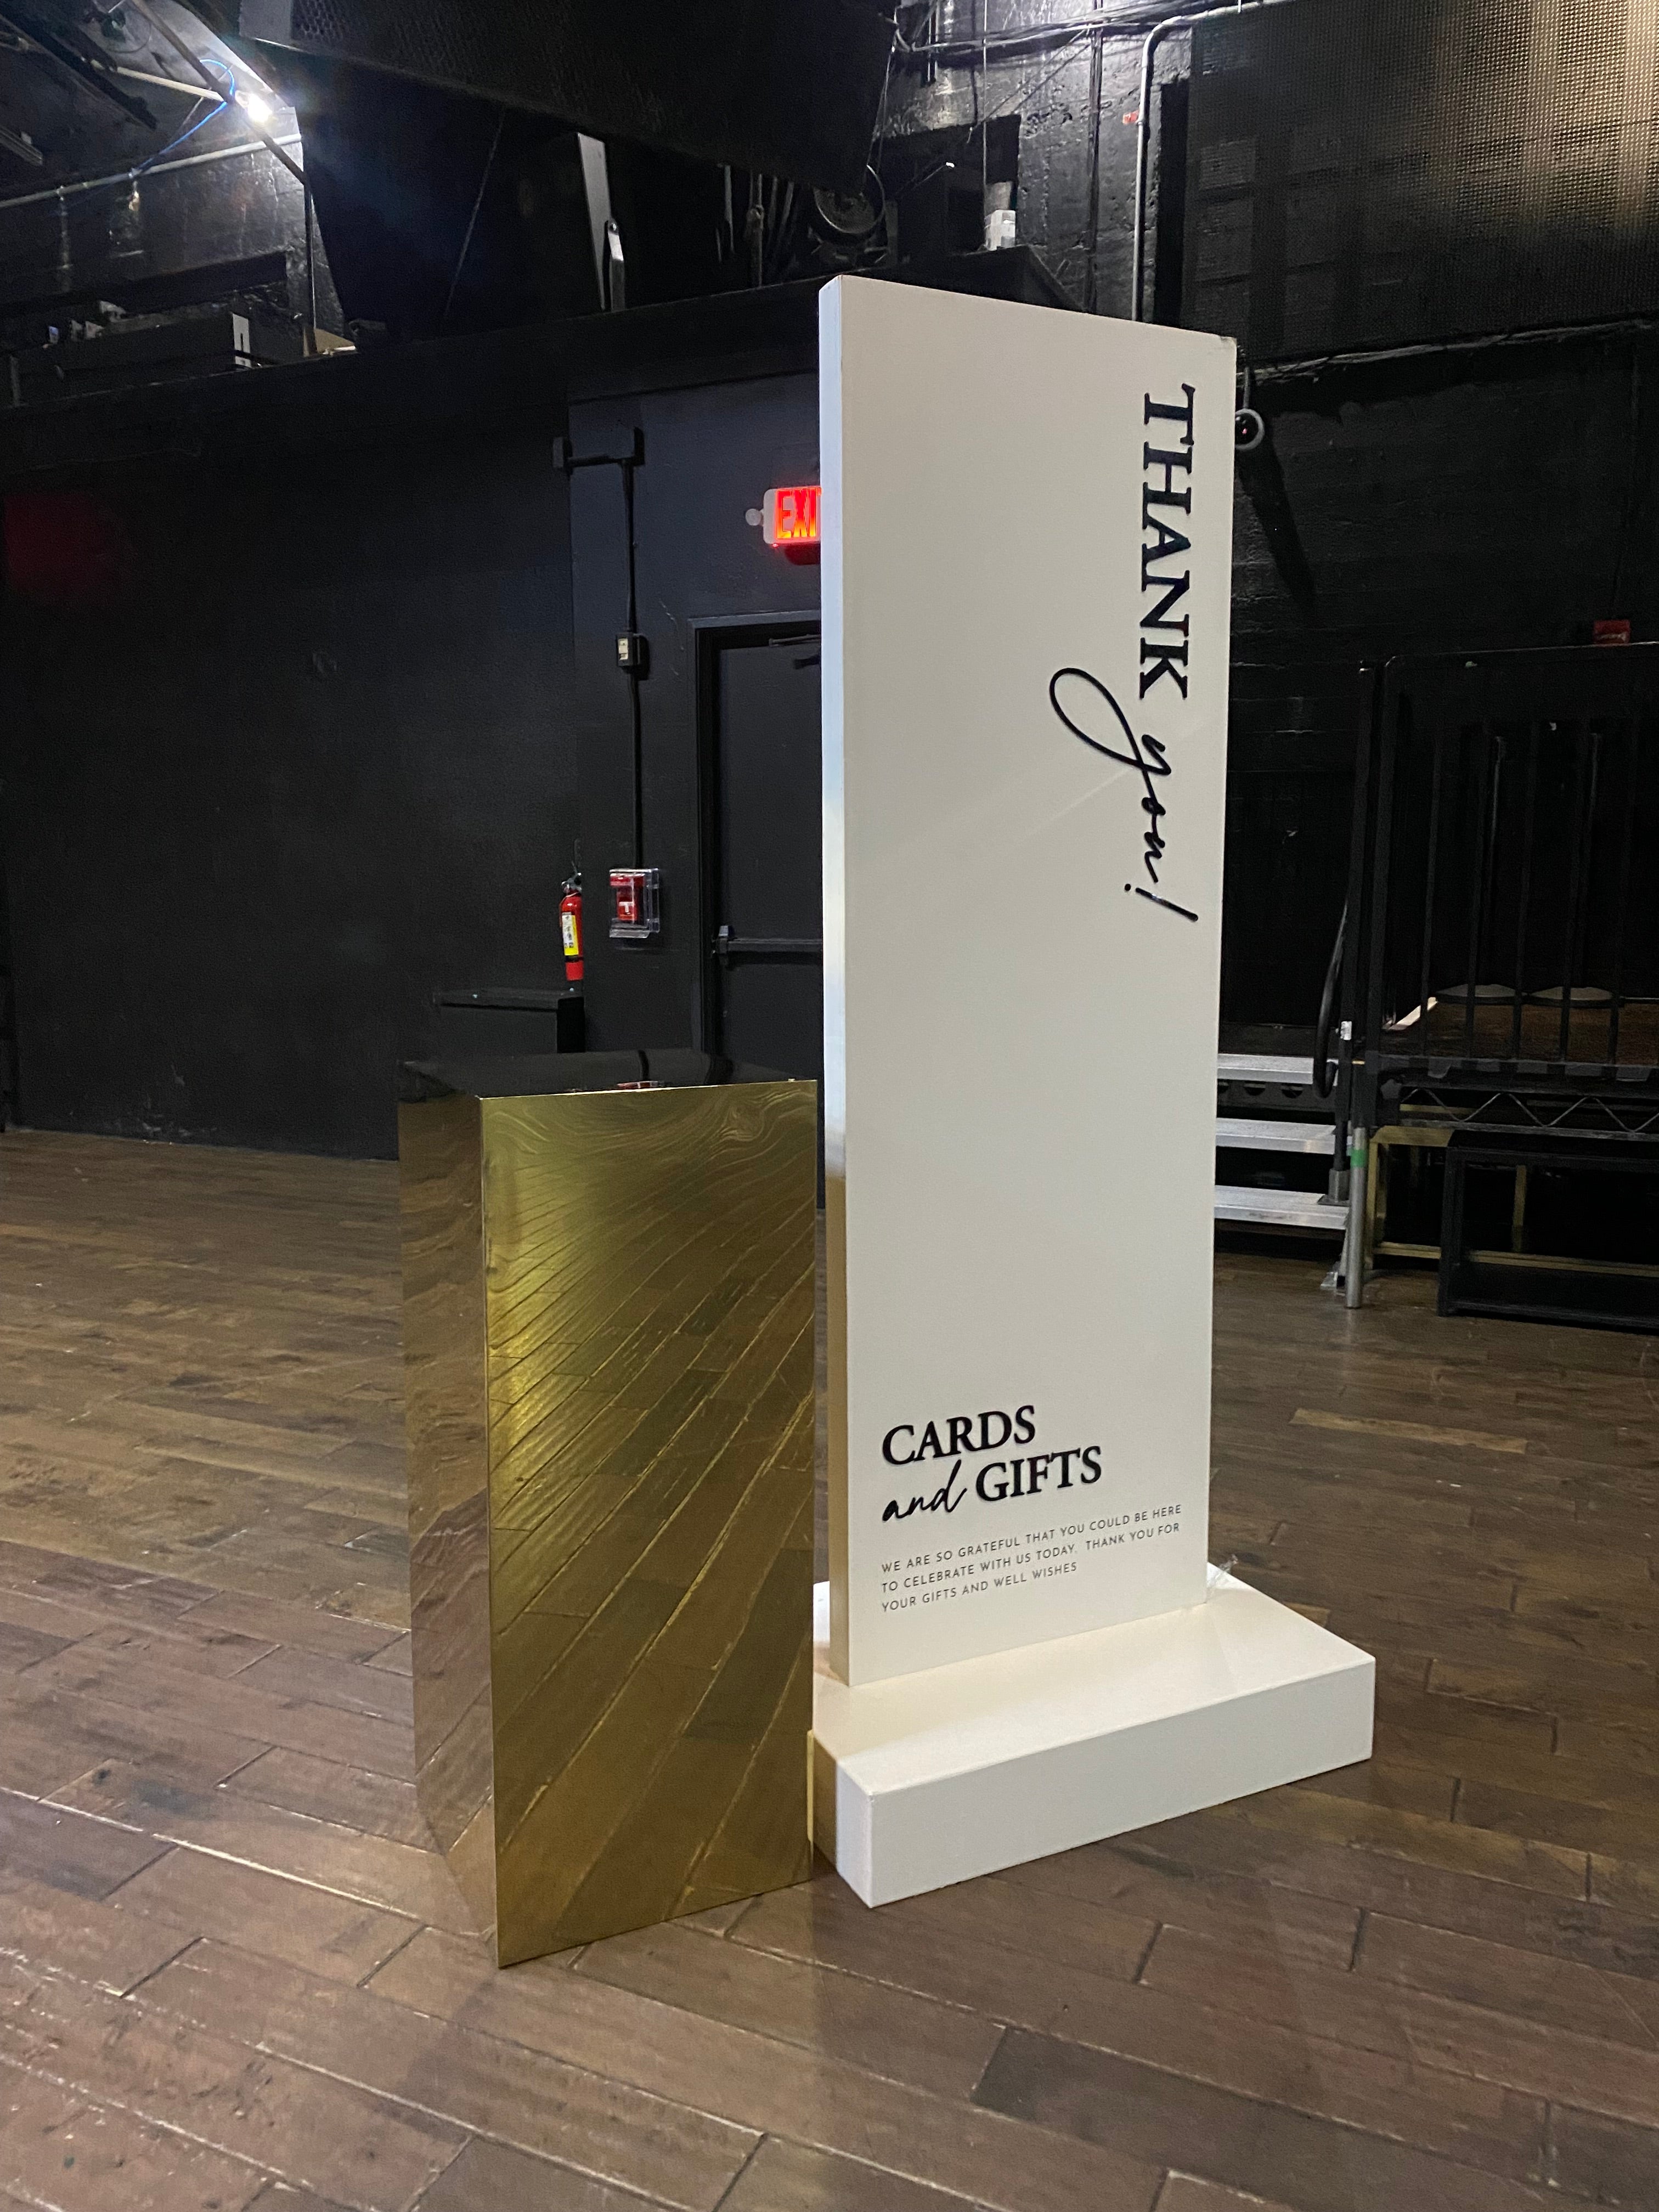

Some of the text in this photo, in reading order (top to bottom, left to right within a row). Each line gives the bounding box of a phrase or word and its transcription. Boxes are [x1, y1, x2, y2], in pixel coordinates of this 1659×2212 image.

[776, 488, 822, 539] EXI
[1049, 383, 1199, 922] THANK you!
[882, 1405, 1036, 1465] CARDS
[882, 1446, 1102, 1522] and GIFTS
[881, 1504, 1182, 1573] WE ARE SO GRATEFUL THAT YOU COULD BE HERE
[881, 1522, 1180, 1593] TO CELEBRATE WITH US TODAY. THANK YOU FOR
[882, 1561, 1077, 1612] YOUR GIFTS AND WELL WISHES
